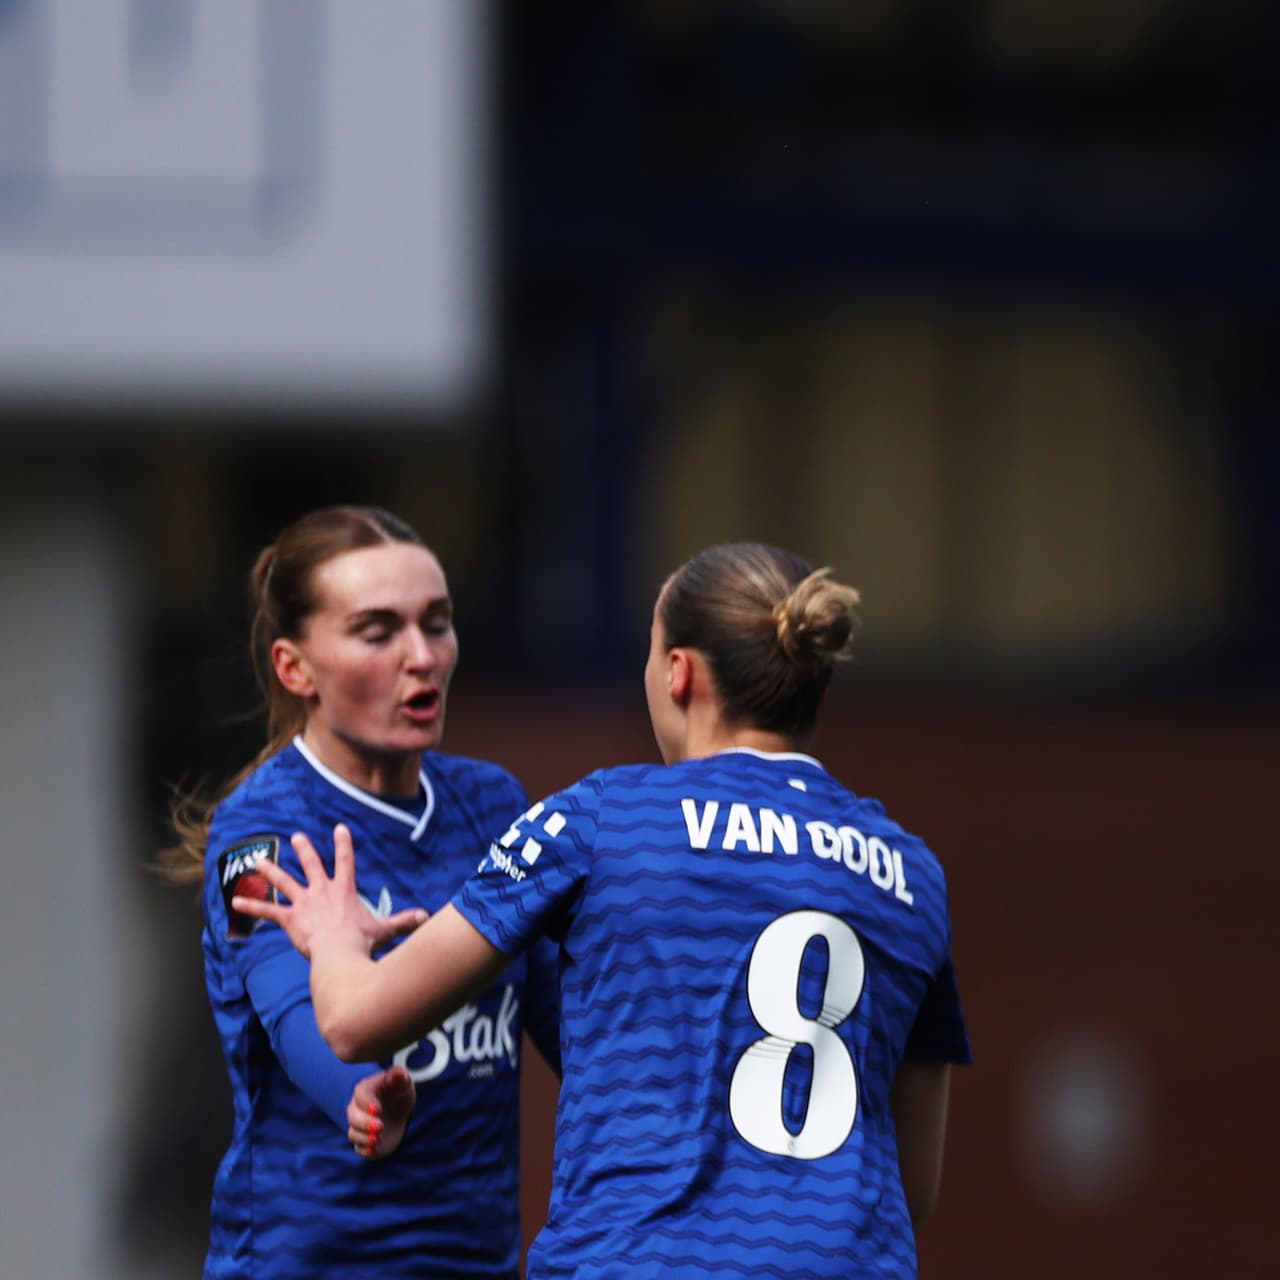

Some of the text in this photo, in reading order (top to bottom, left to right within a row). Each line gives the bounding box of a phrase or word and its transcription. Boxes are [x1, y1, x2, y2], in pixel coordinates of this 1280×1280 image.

[681, 798, 914, 906] VAN GOOL
[729, 909, 866, 1161] 8
